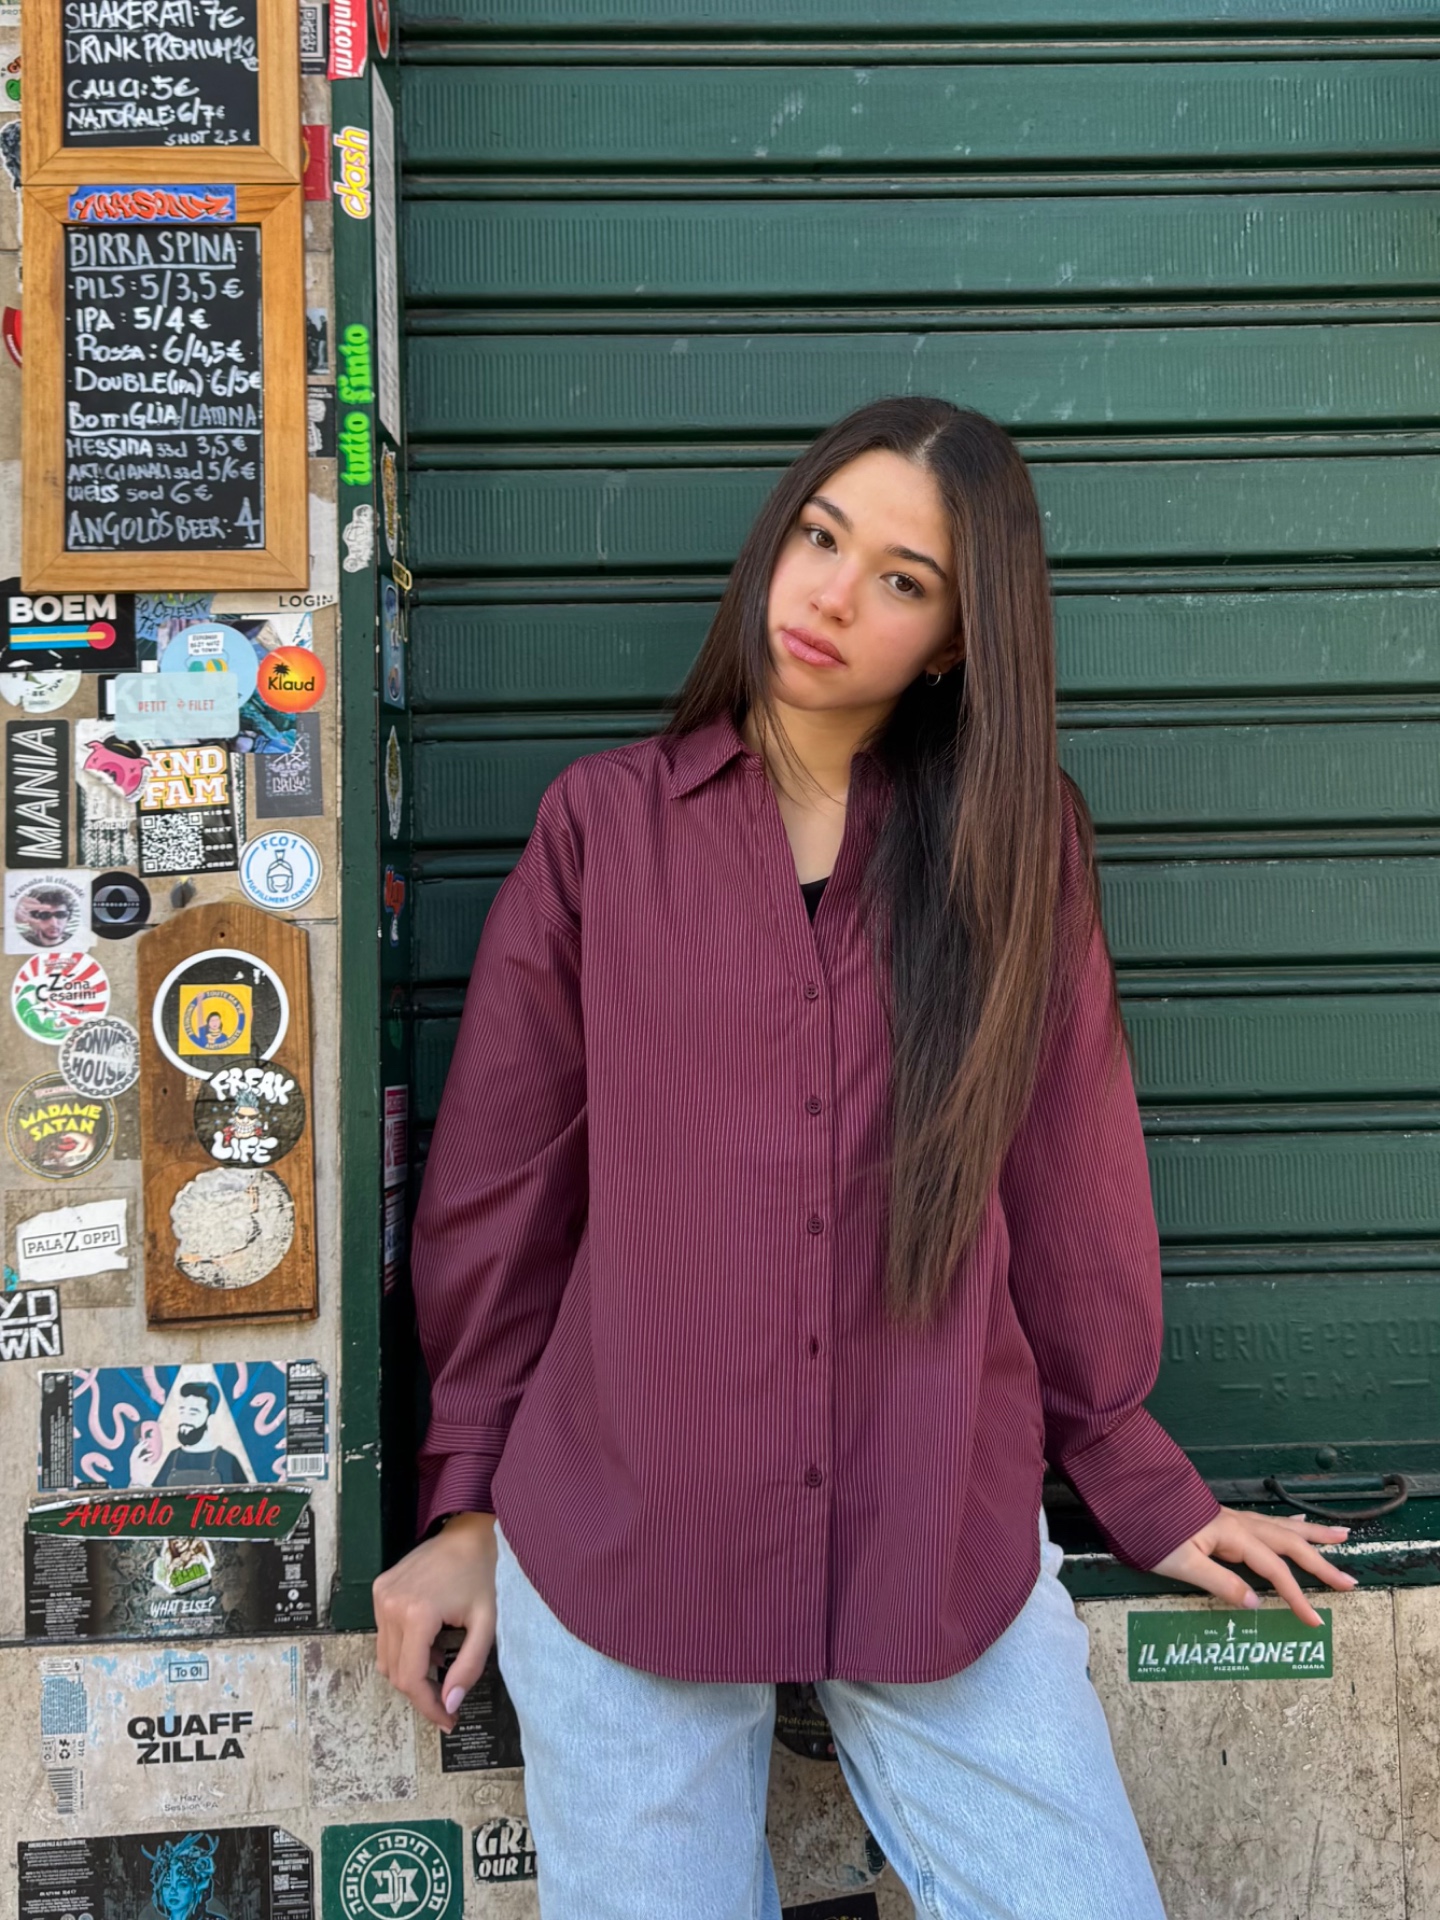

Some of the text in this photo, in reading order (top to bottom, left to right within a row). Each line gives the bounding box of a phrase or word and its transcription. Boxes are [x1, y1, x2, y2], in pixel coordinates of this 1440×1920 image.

[65, 34, 142, 65] DRINK
[164, 130, 210, 146] SHOT
[69, 230, 243, 267] BIRRA SPINA:
[133, 304, 185, 335] 5/4
[338, 323, 374, 404] finto
[338, 412, 373, 486] tutto
[169, 480, 192, 504] 6
[8, 593, 117, 624] BOEM
[268, 677, 315, 691] Klaud
[188, 699, 215, 711] FILET
[11, 727, 63, 860] MANIA
[143, 776, 227, 808] FAM
[290, 878, 313, 900] CENTER
[36, 984, 96, 1002] Cesarini
[48, 973, 91, 991] Zona
[210, 1067, 295, 1106] FREAK
[19, 1103, 102, 1130] MADAME
[29, 1117, 96, 1142] SATAN
[211, 1130, 279, 1164] LIFE
[58, 1497, 174, 1536] Angolo
[150, 1596, 217, 1619] WHAT ELSE?
[1138, 1640, 1326, 1666] IL MARATONETA
[174, 1665, 187, 1678] To
[127, 1711, 253, 1742] QUAFF
[136, 1737, 245, 1765] ZILLA
[202, 1801, 219, 1810] PA
[377, 1834, 430, 1857] חיפה
[478, 1857, 518, 1877] OUR
[428, 1857, 446, 1912] מכבי
